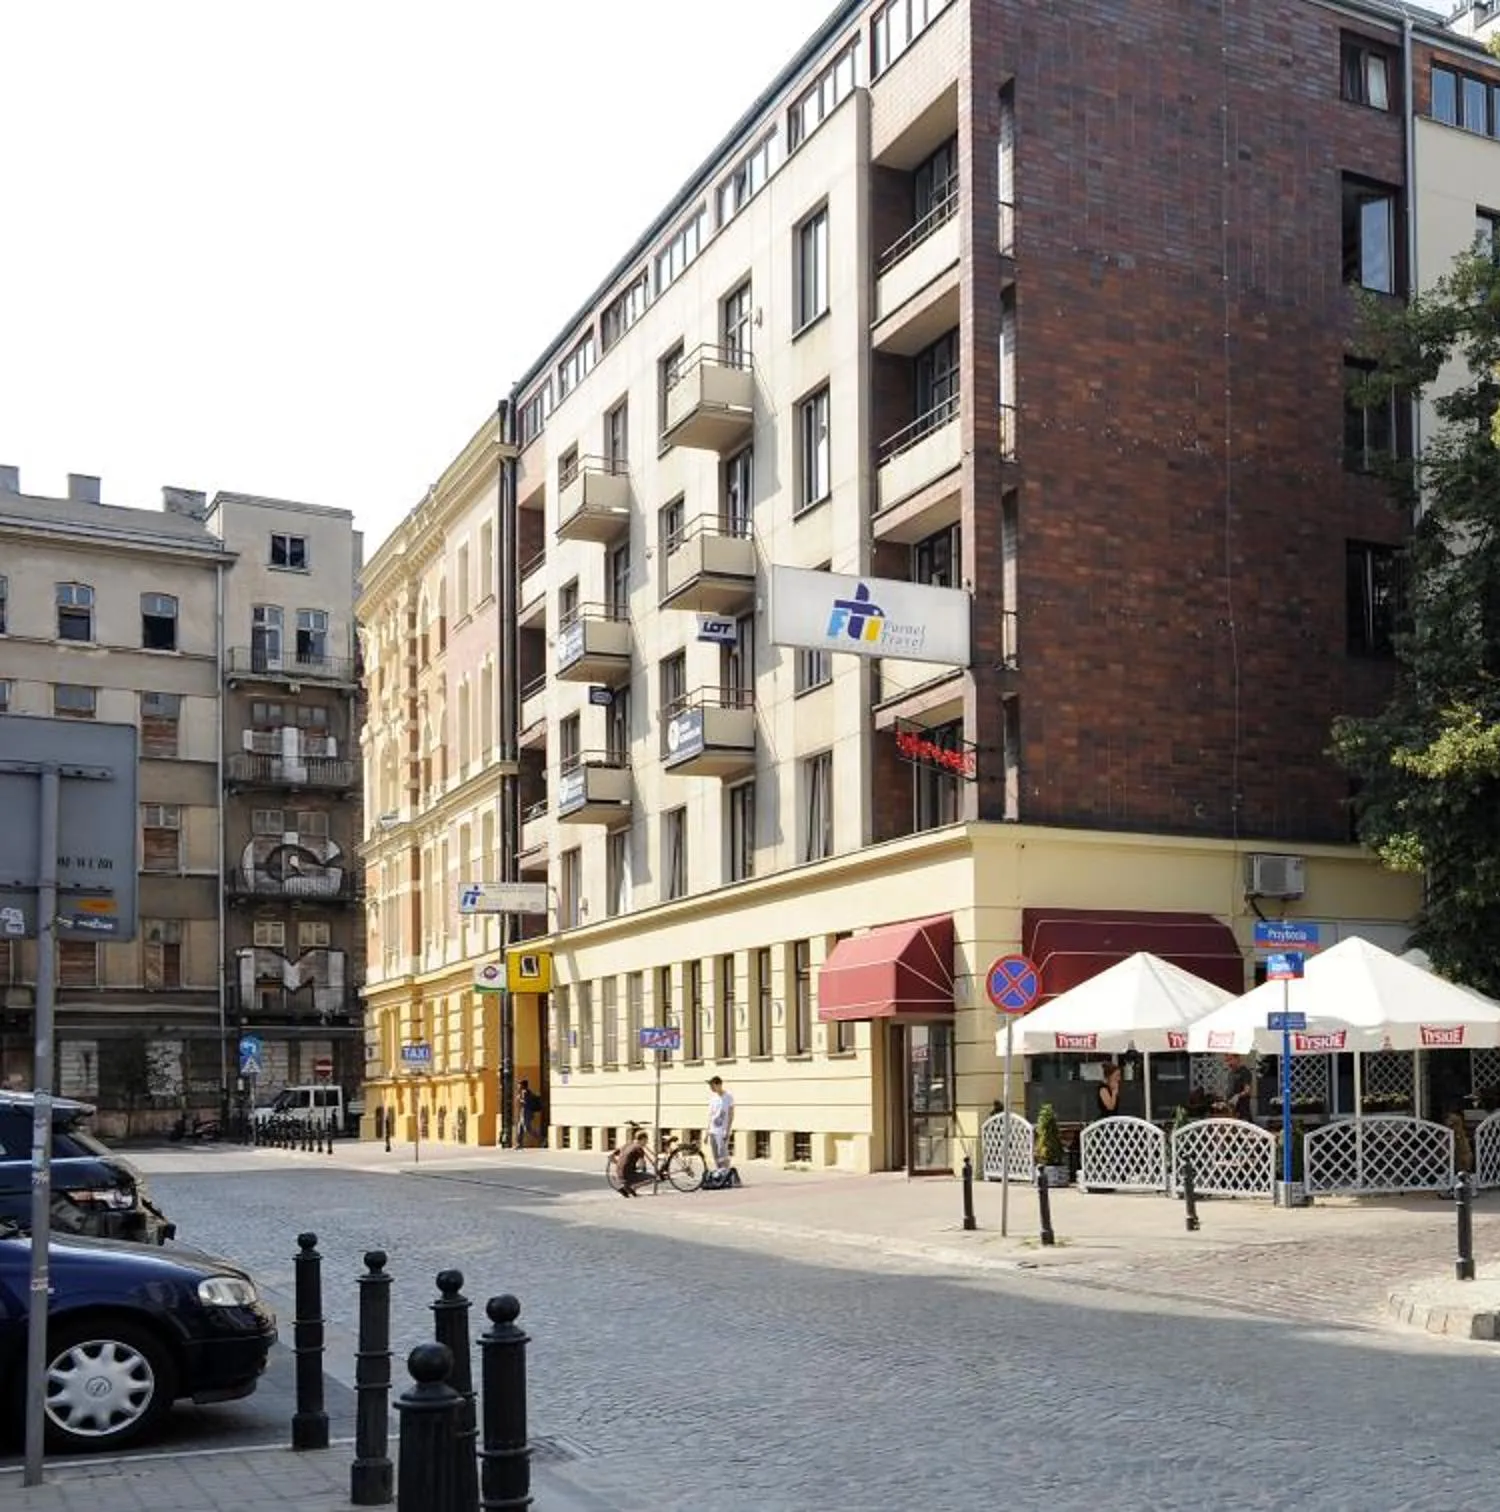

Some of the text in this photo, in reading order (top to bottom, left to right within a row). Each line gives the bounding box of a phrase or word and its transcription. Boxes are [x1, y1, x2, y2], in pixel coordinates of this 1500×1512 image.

[703, 621, 732, 634] LOT
[1057, 1034, 1096, 1048] TYSKIE
[1298, 1034, 1345, 1050] TYSKIE
[1422, 1028, 1463, 1044] TYSKIE
[402, 1047, 428, 1059] TAXI
